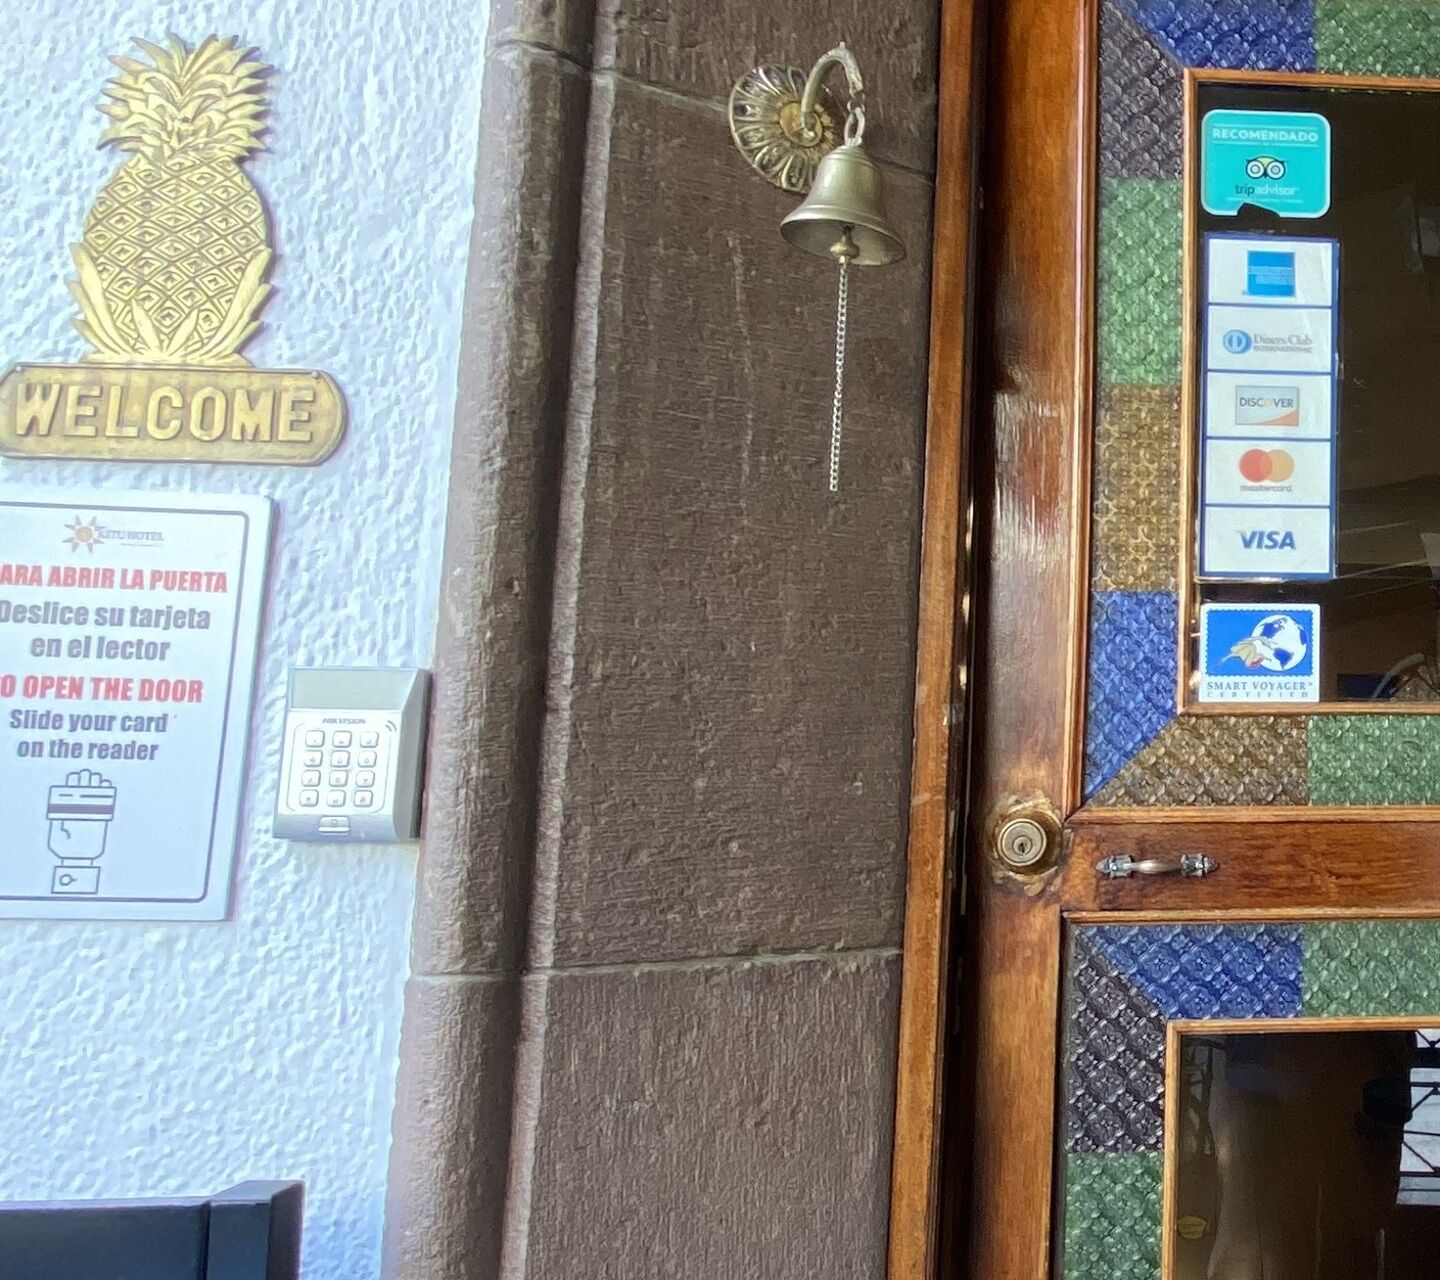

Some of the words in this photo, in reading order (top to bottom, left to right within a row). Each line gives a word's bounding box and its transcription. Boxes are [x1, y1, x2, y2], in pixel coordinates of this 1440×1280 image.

[1212, 128, 1319, 142] RECOMENDADO
[1234, 183, 1298, 197] tripadvisor
[15, 382, 315, 443] WELCOME
[1239, 397, 1294, 408] DISCOVER
[1238, 530, 1296, 550] VISA
[0, 564, 43, 587] ARA
[47, 565, 116, 589] ABRIR
[119, 568, 145, 591] LA
[149, 569, 228, 594] PUERTA
[0, 599, 89, 626] Deslice
[93, 605, 125, 628] su
[129, 605, 211, 631] tarjeta
[30, 637, 62, 658] en
[67, 635, 92, 660] el
[96, 636, 171, 661] lector
[0, 674, 16, 698] O
[22, 674, 85, 701] OPEN
[90, 677, 134, 701] THE
[137, 678, 204, 703] DOOR
[1207, 681, 1248, 691] SMART
[9, 709, 64, 730] Slide
[68, 714, 117, 733] your
[120, 712, 169, 733] card
[17, 740, 44, 758] on
[49, 738, 83, 760] the
[87, 740, 159, 761] reader
